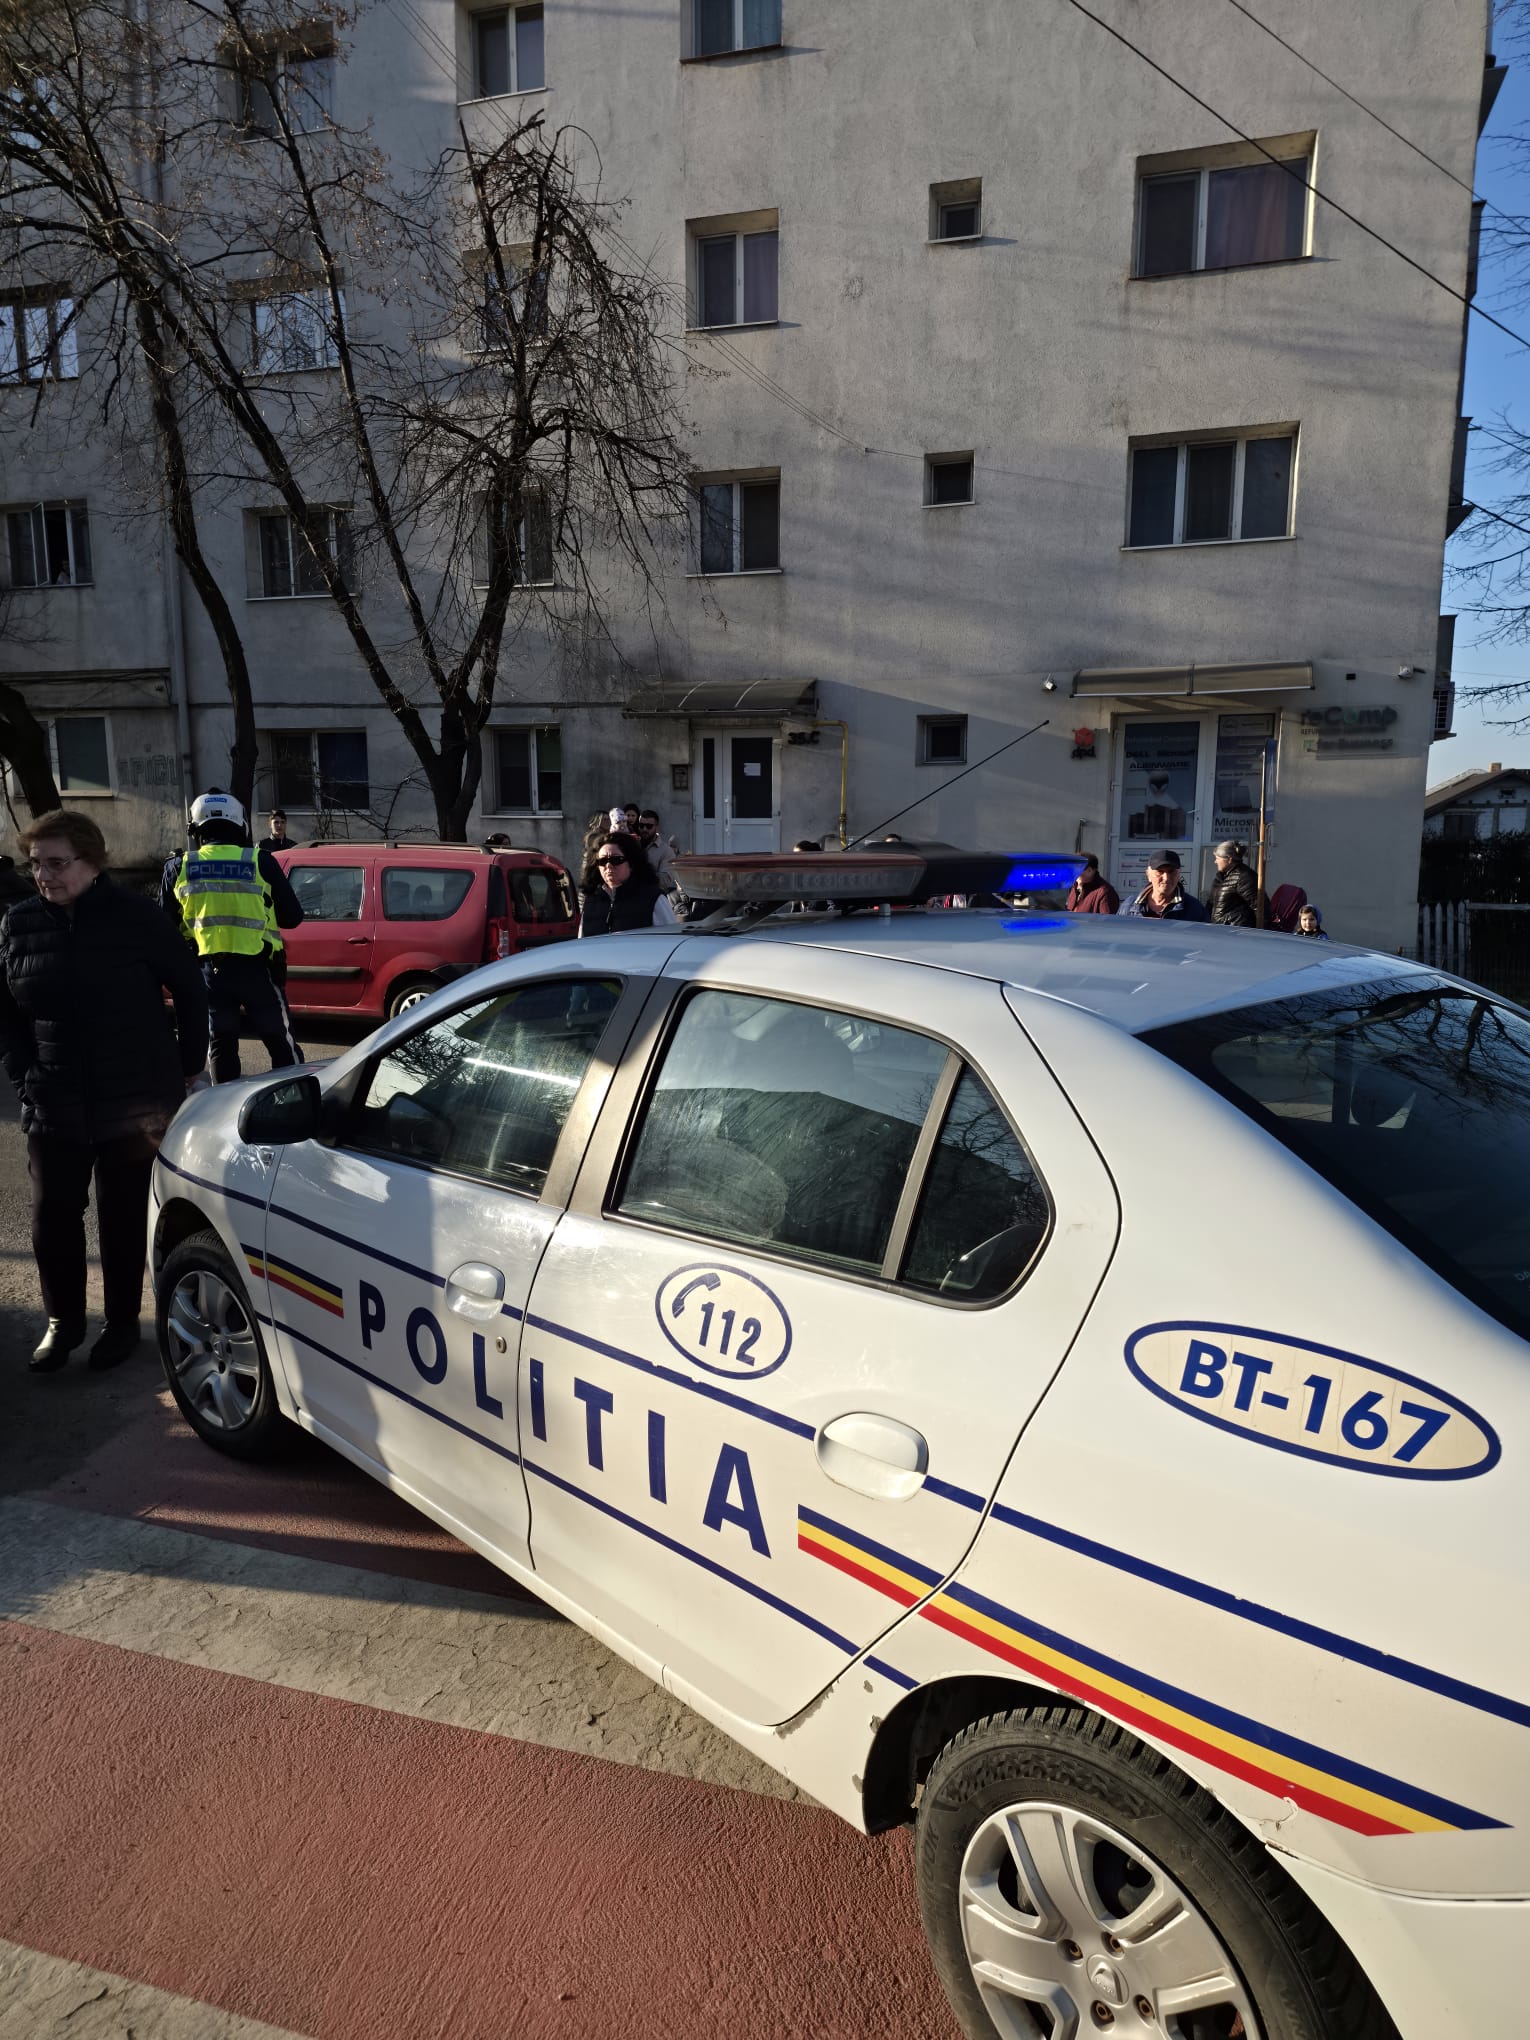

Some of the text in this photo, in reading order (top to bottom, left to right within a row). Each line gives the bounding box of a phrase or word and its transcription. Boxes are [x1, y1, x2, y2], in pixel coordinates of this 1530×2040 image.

[1071, 745, 1097, 760] dpd
[190, 863, 252, 877] POLITIA
[698, 1302, 762, 1366] 112
[359, 1280, 771, 1559] POLITIA
[1179, 1339, 1451, 1463] BT-167
